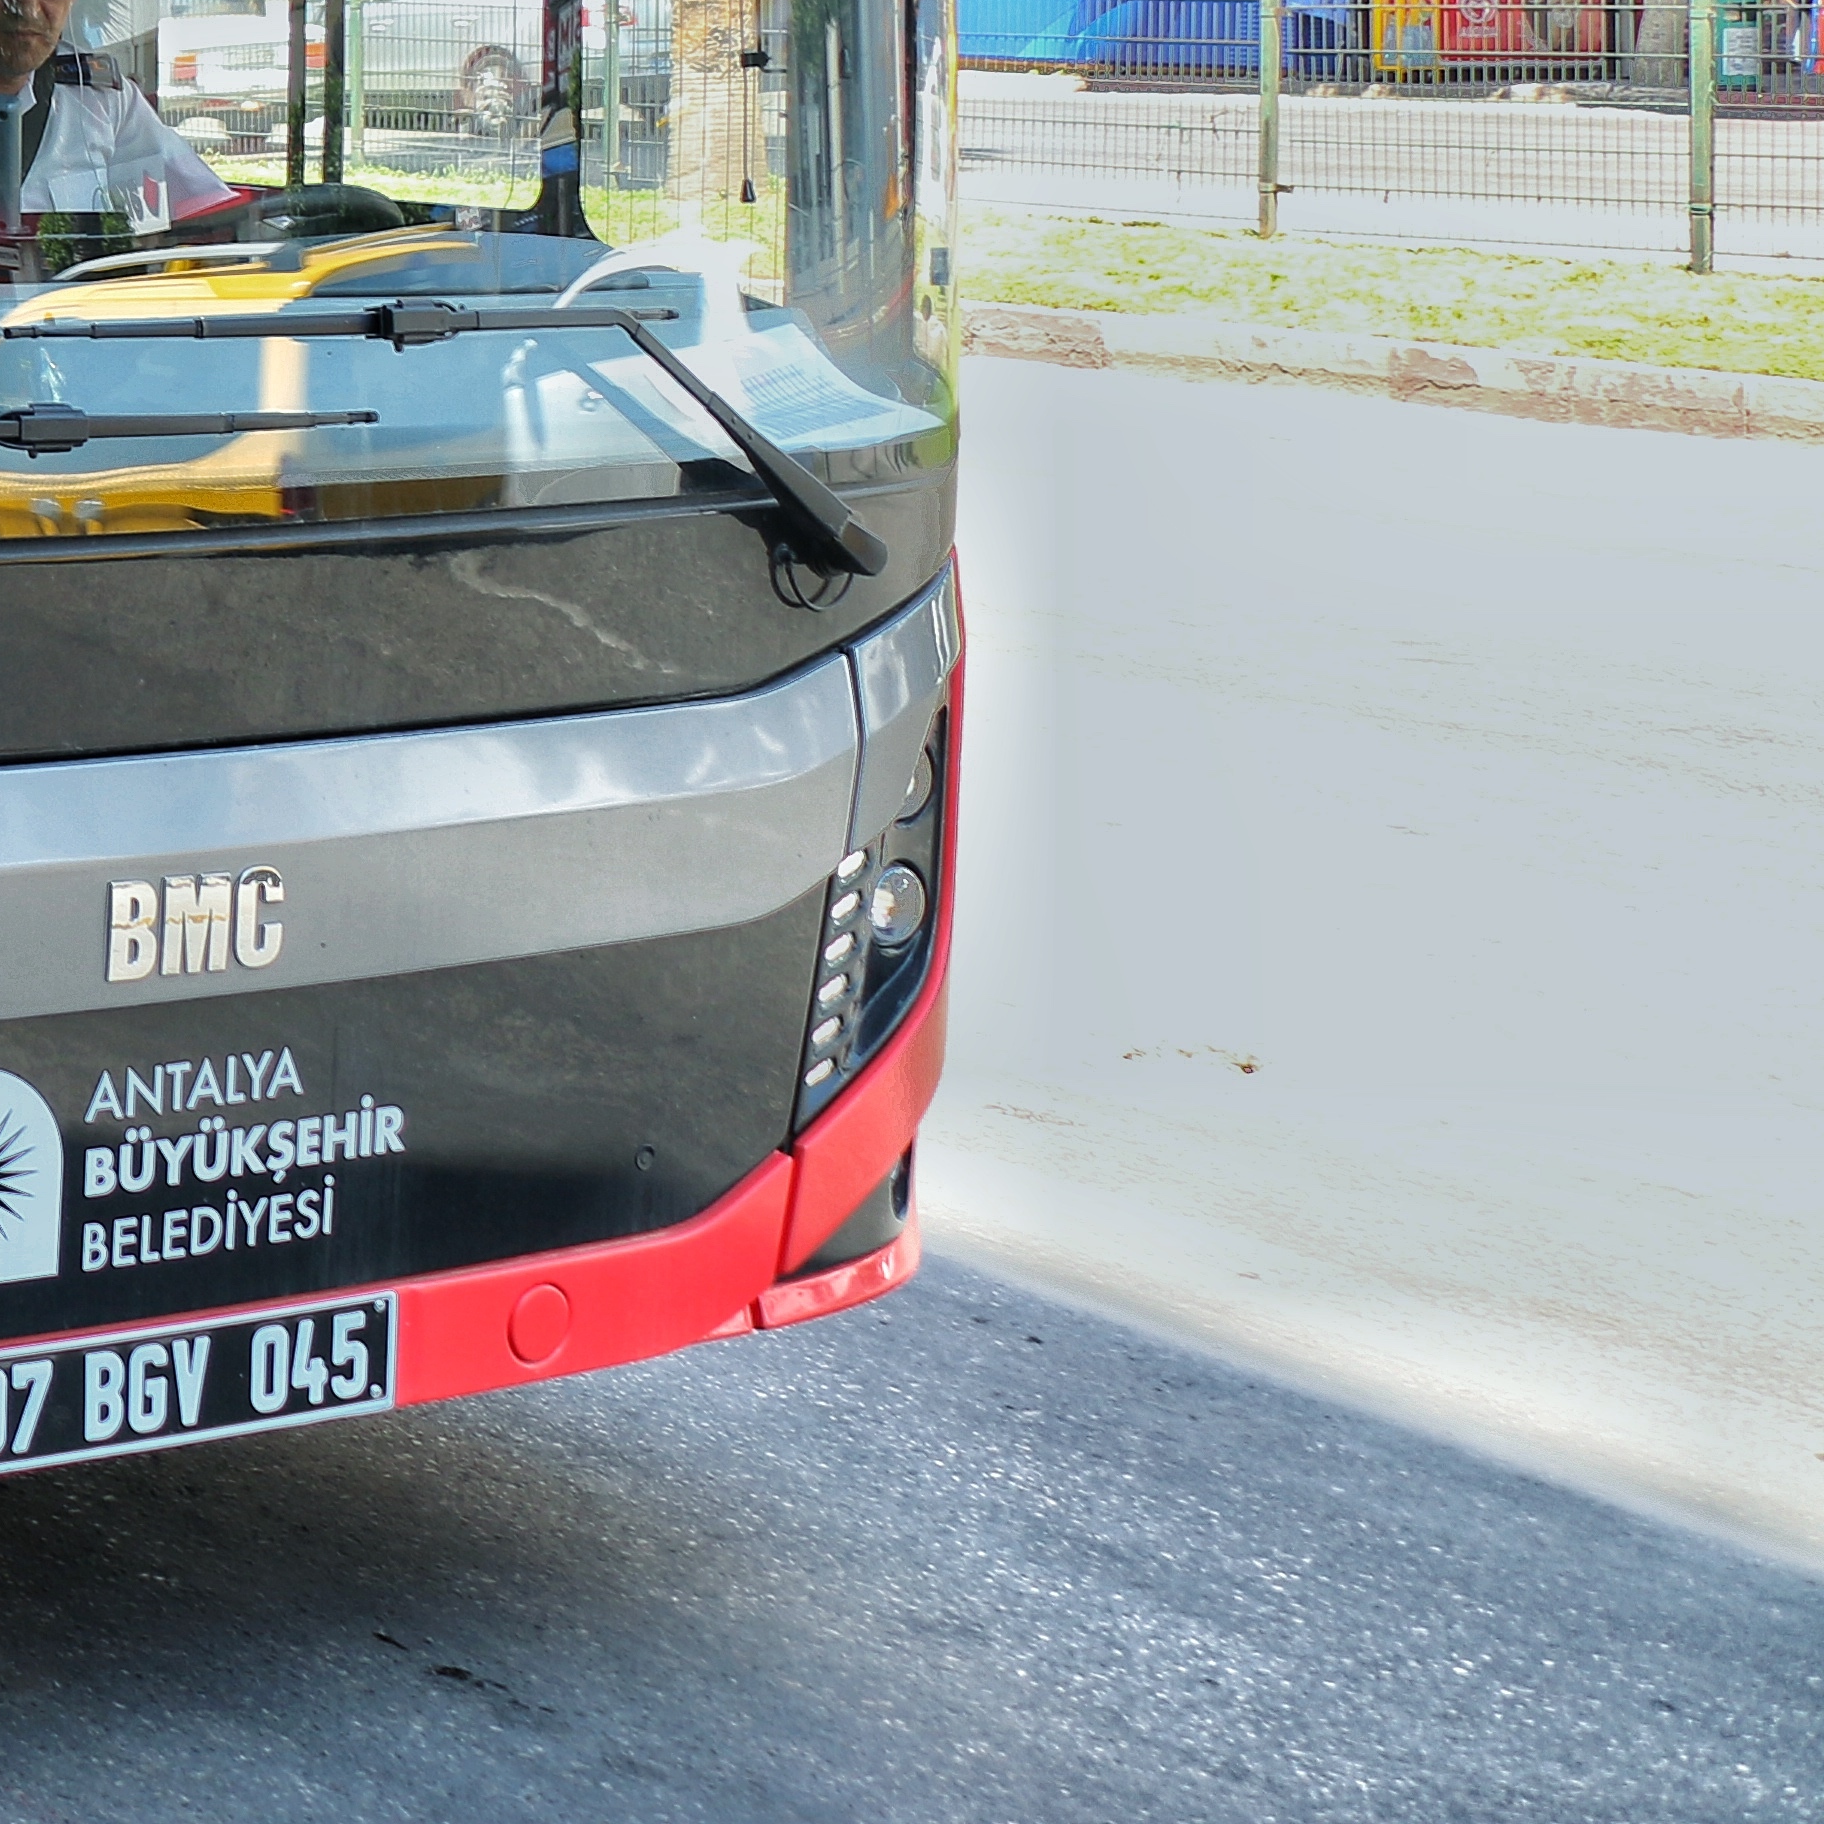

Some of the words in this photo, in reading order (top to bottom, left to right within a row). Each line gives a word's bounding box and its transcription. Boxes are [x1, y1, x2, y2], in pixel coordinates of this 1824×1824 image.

[105, 864, 285, 983] BMC
[84, 1046, 304, 1125] ANTALYA
[83, 1093, 406, 1199] BÜYÜKŞEHİR
[81, 1174, 336, 1273] BELEDİYESİ
[84, 1335, 211, 1443] BGV
[249, 1309, 370, 1415] 045
